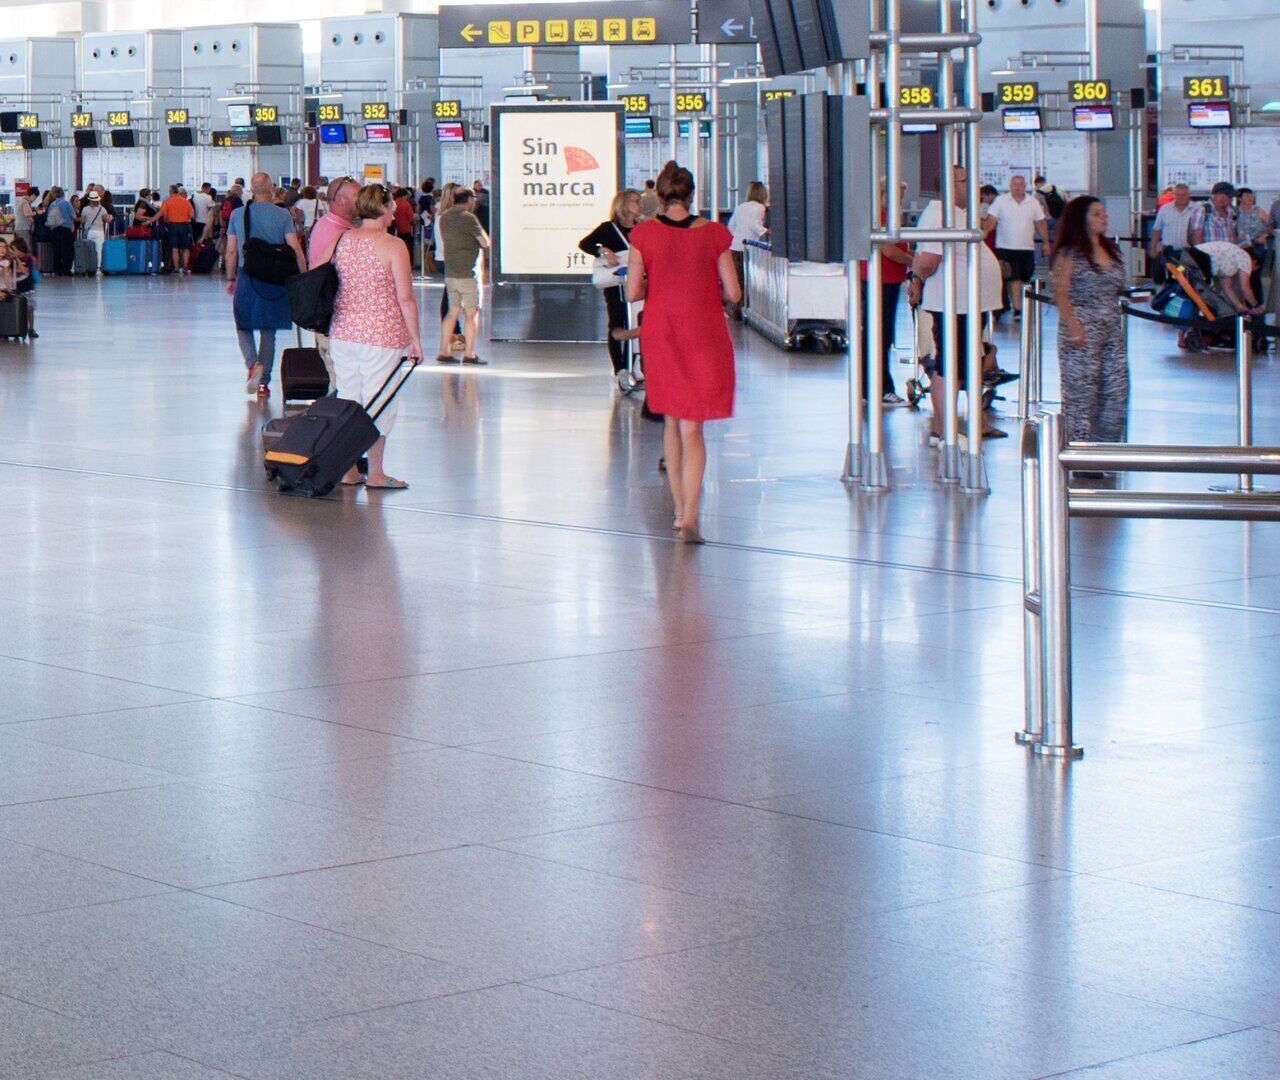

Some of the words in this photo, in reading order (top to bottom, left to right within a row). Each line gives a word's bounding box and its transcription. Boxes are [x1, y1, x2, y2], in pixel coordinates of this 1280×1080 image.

[900, 86, 931, 104] 358
[1002, 85, 1034, 102] 359
[1073, 82, 1108, 100] 360
[1188, 79, 1223, 96] 361
[435, 102, 458, 117] 353
[676, 94, 703, 110] 356
[109, 111, 128, 125] 348
[167, 110, 186, 124] 349
[255, 108, 276, 121] 350
[319, 105, 340, 120] 351
[364, 104, 386, 118] 352
[19, 115, 36, 127] 346
[73, 112, 91, 126] 347
[522, 138, 558, 155] Sin
[522, 162, 548, 175] su
[523, 182, 595, 196] marca
[566, 252, 587, 268] jft
